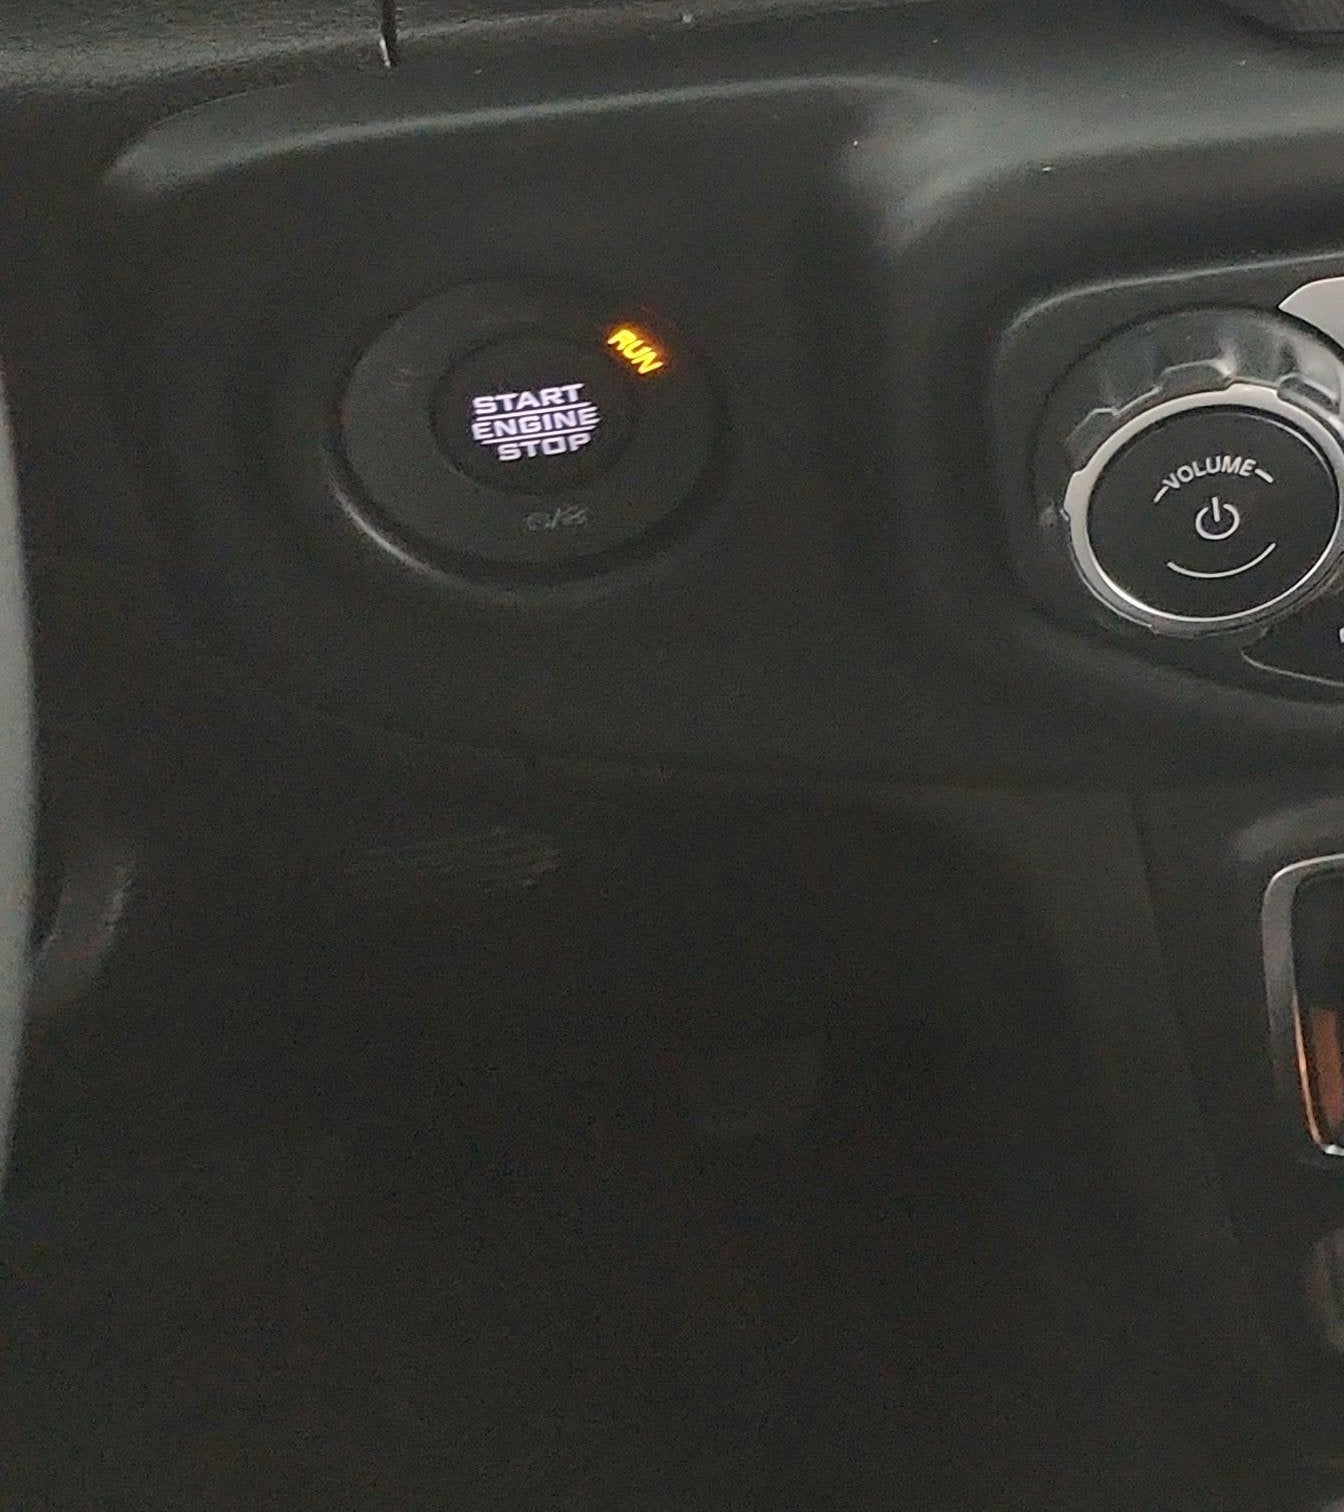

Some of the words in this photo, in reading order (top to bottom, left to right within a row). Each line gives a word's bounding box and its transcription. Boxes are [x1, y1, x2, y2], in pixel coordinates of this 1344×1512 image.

[608, 329, 662, 375] RUN
[472, 383, 584, 415] START
[471, 406, 600, 440] ENGINE
[498, 433, 591, 461] STOP
[1164, 455, 1256, 490] VOLUME
